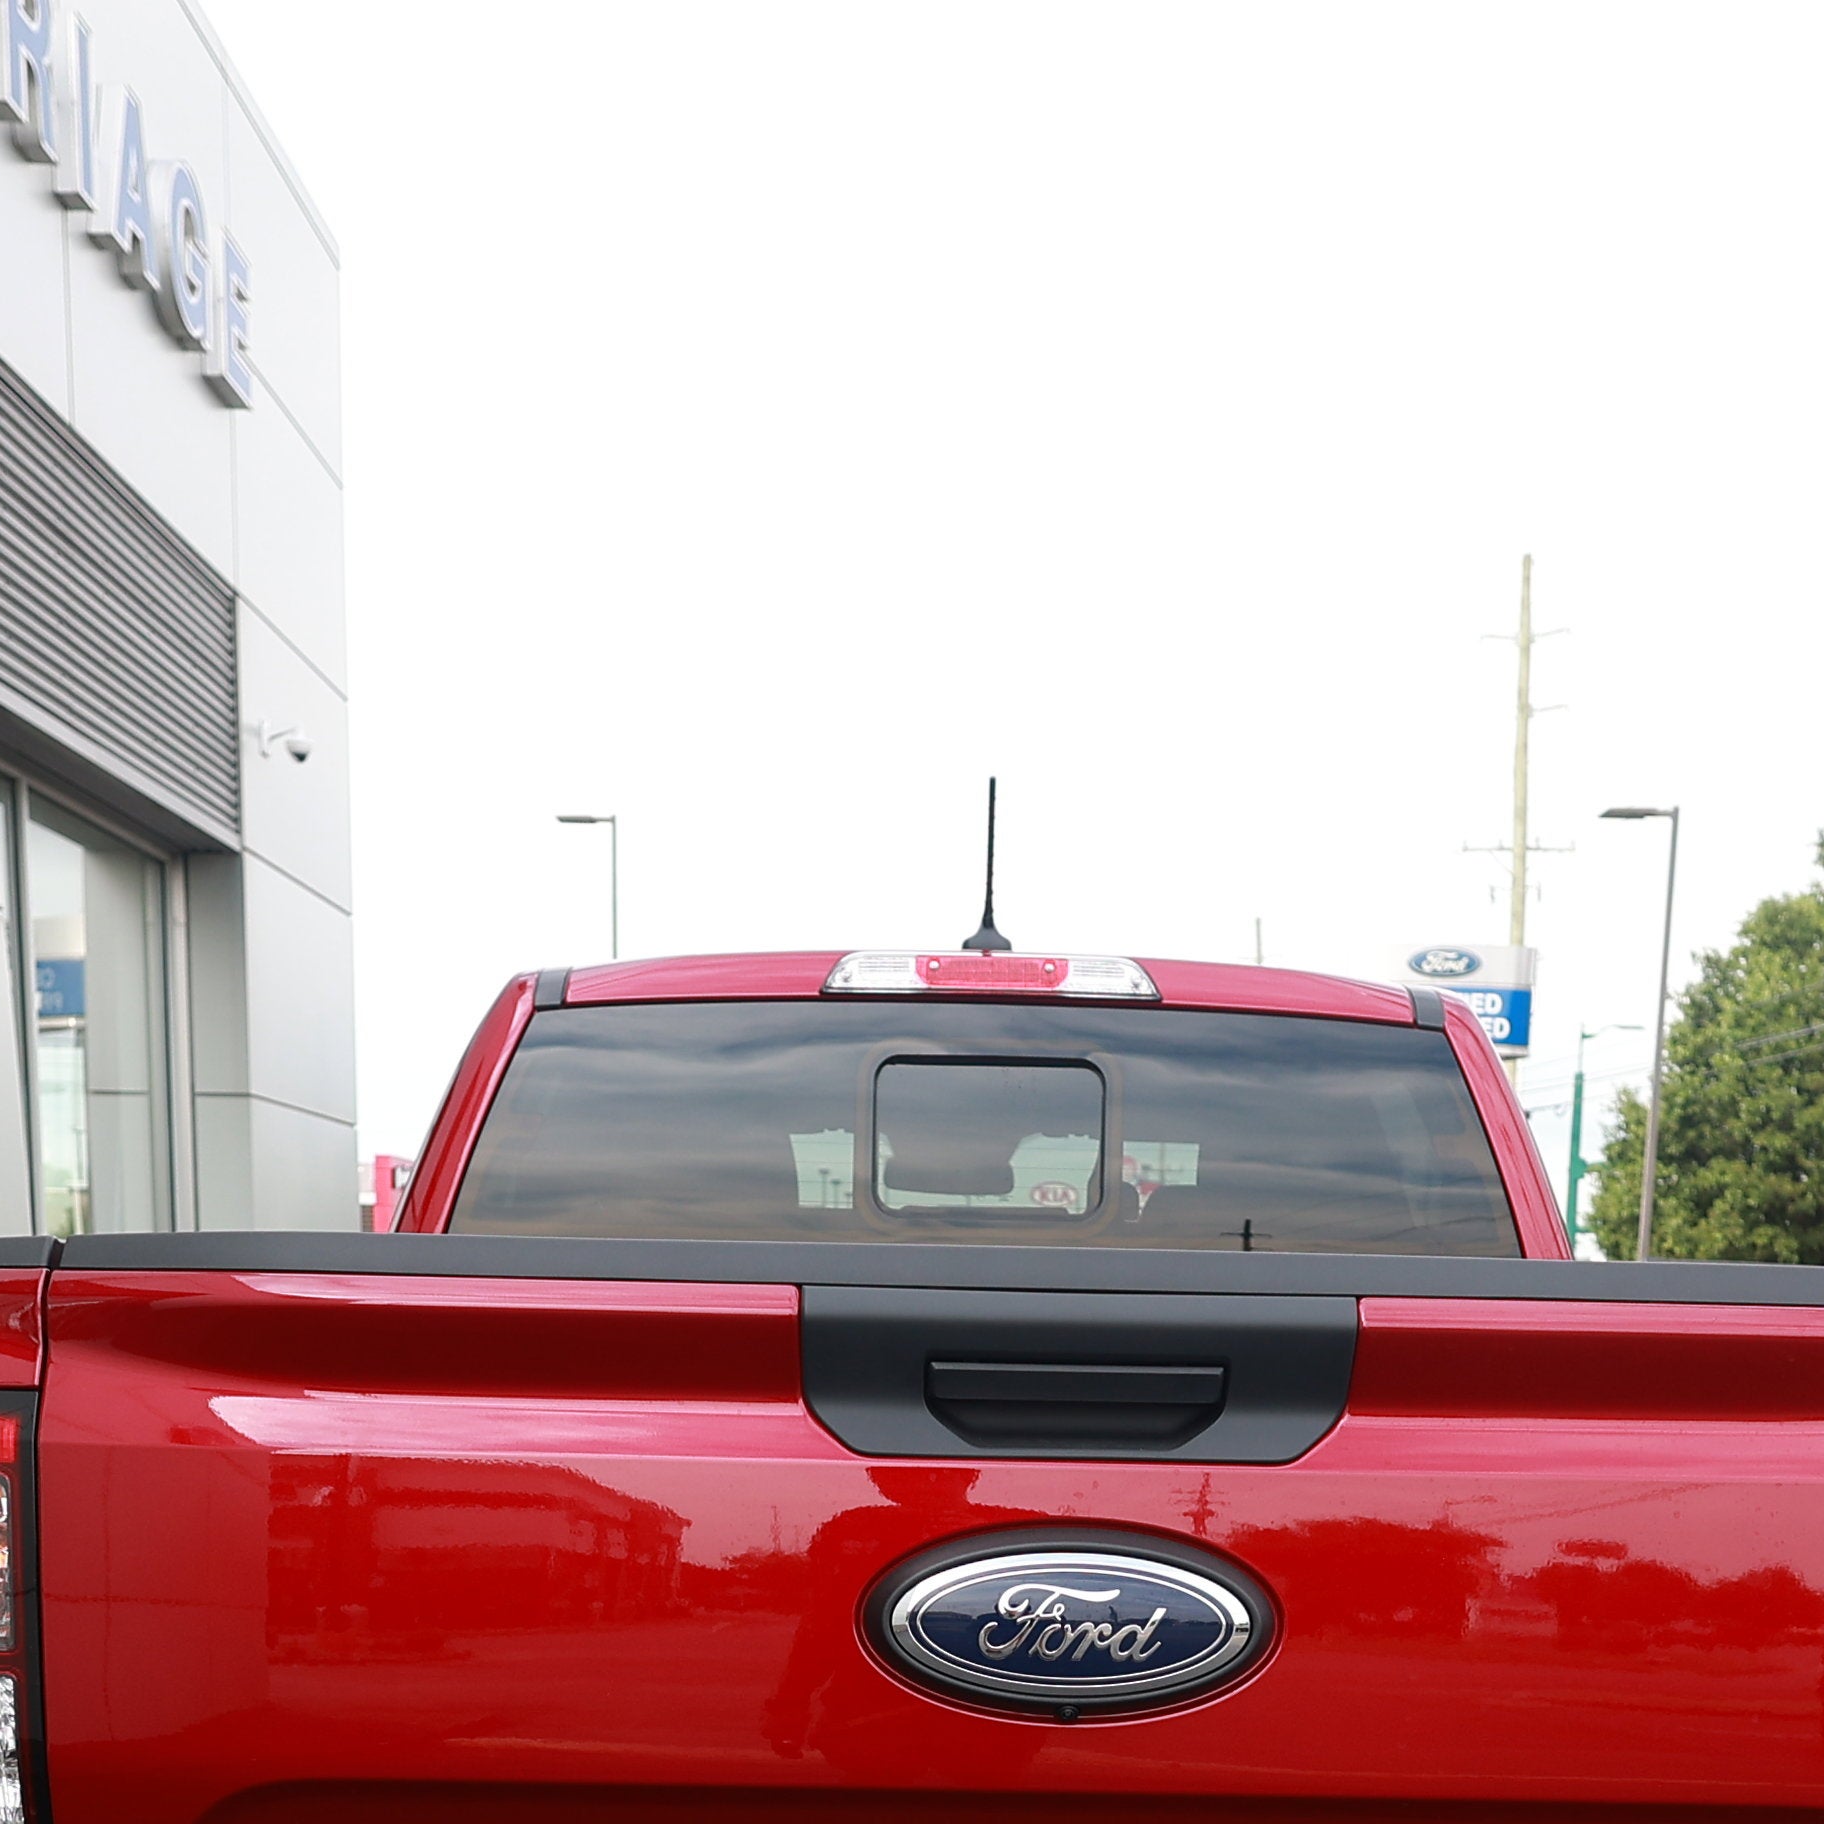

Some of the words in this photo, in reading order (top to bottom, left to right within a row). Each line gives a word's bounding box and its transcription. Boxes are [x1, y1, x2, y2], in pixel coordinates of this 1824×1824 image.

[1421, 949, 1470, 974] Ford
[1037, 1187, 1074, 1202] KIA
[978, 1583, 1167, 1662] Ford
